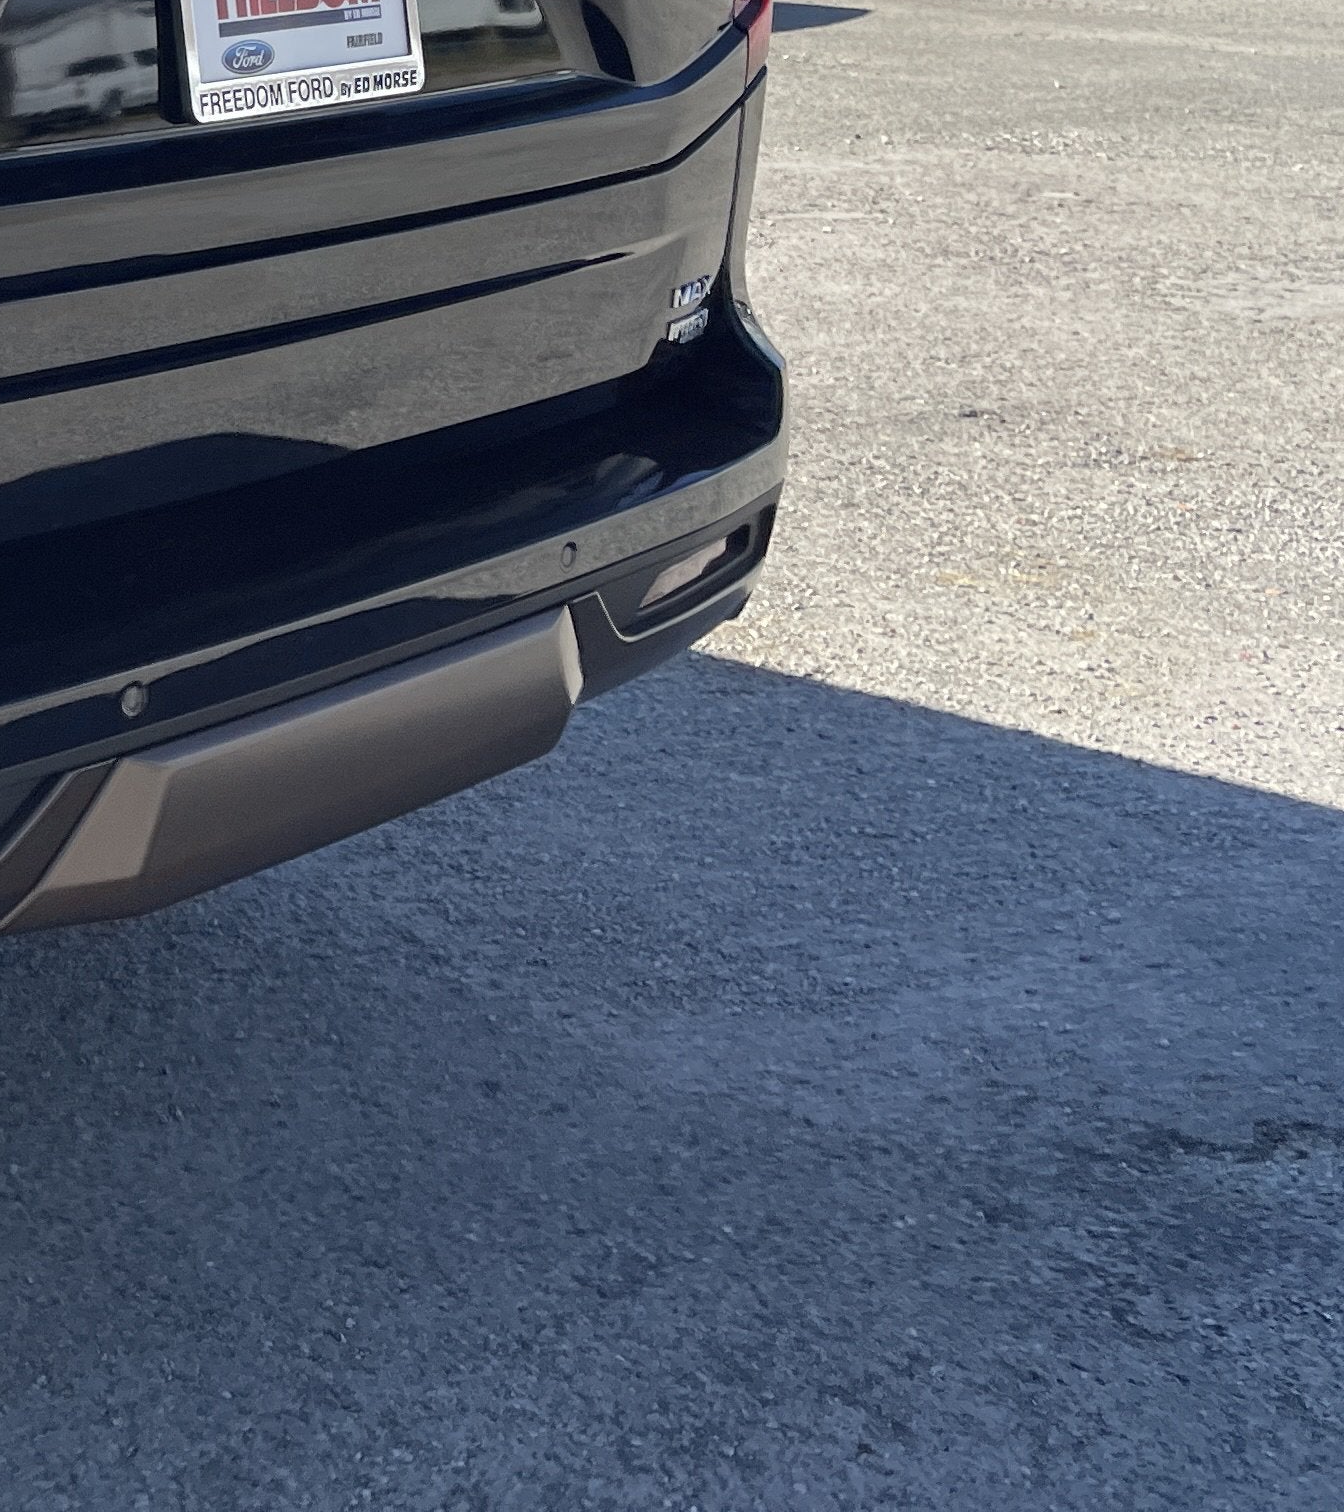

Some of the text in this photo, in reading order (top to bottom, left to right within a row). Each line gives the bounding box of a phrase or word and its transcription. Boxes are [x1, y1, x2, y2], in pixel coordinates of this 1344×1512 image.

[232, 46, 265, 68] Ford
[199, 84, 284, 117] FREEDOM
[288, 76, 335, 103] FORD
[354, 76, 370, 94] ED
[373, 69, 418, 92] MORSE
